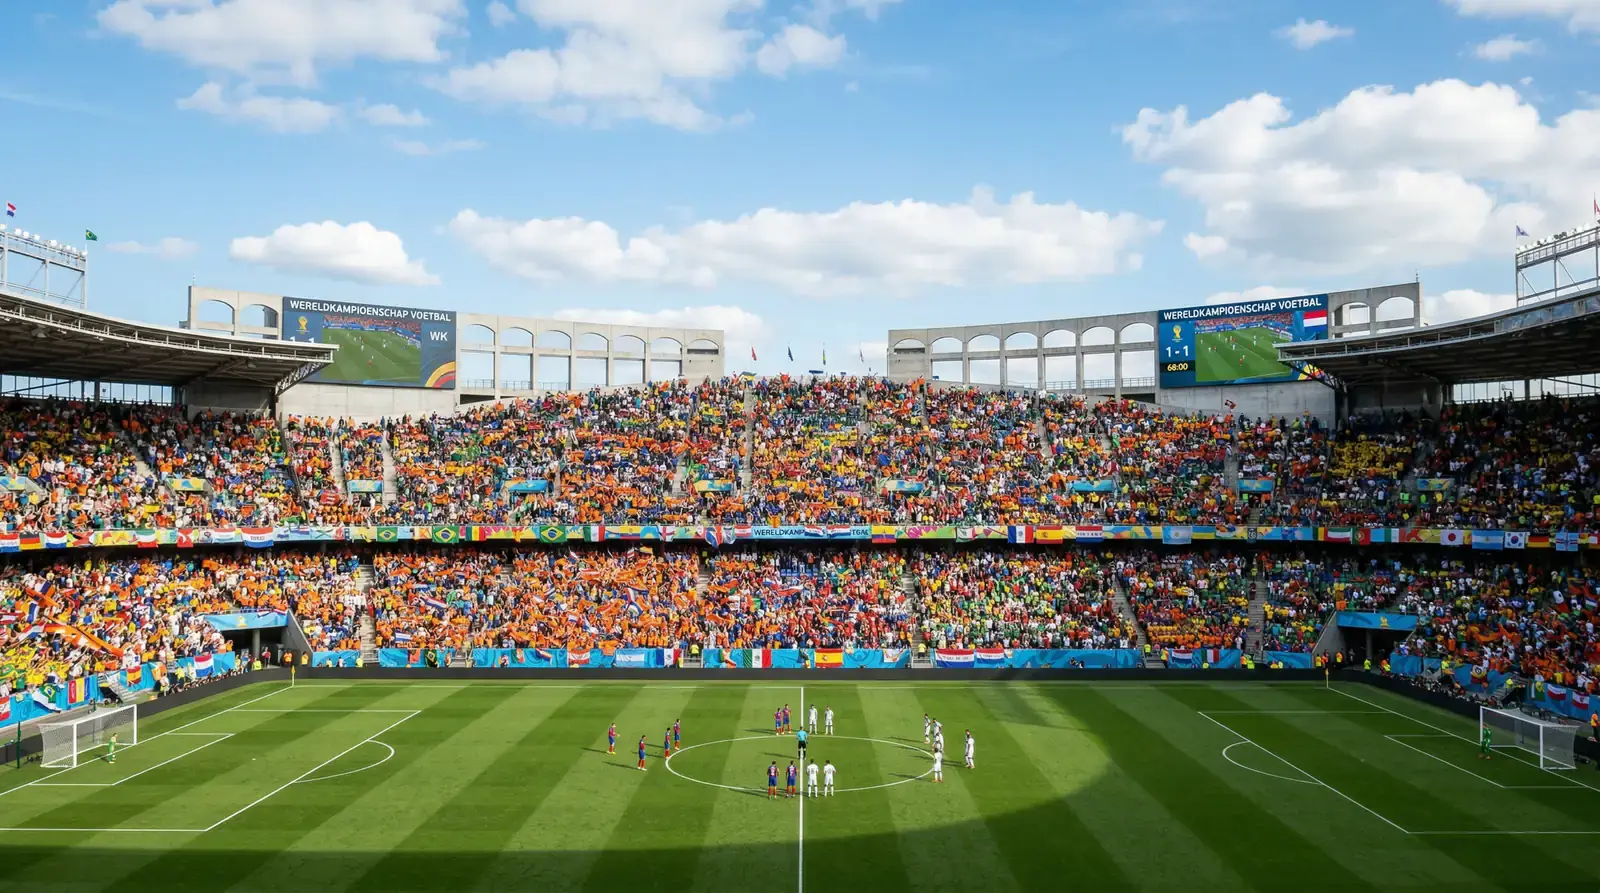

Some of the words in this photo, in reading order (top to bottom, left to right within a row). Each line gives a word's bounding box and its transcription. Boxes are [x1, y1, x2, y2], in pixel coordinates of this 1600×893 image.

[290, 300, 409, 318] WERELDKAMPIOENSCHAP
[411, 311, 451, 322] VOETBAL
[1163, 302, 1277, 320] WERELDKAMPIOENSCHAP
[1279, 297, 1322, 310] VOETBAL
[429, 331, 448, 341] WK
[1167, 362, 1189, 372] 68:00
